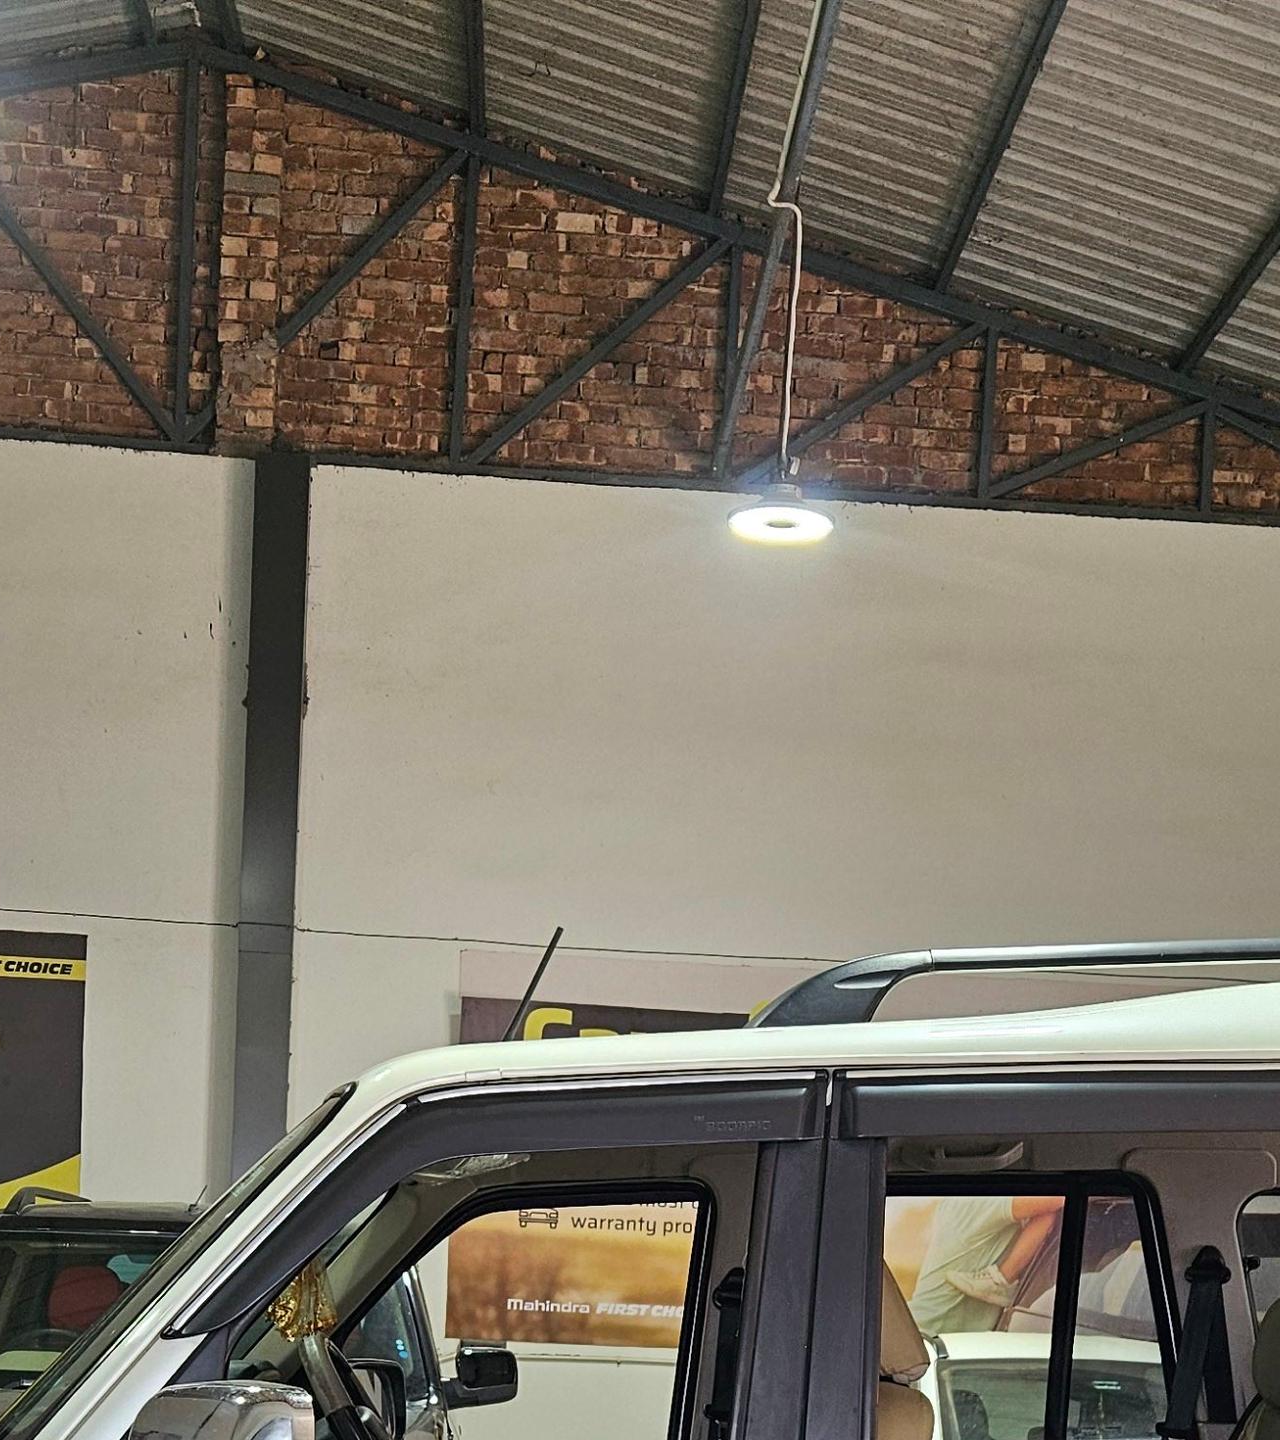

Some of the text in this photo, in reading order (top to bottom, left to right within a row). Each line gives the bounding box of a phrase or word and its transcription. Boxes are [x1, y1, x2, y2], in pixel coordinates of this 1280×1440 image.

[3, 961, 73, 976] CHOICE
[570, 1216, 693, 1237] warranty pro
[506, 1298, 591, 1314] Mahindra
[595, 1302, 650, 1316] FIRST
